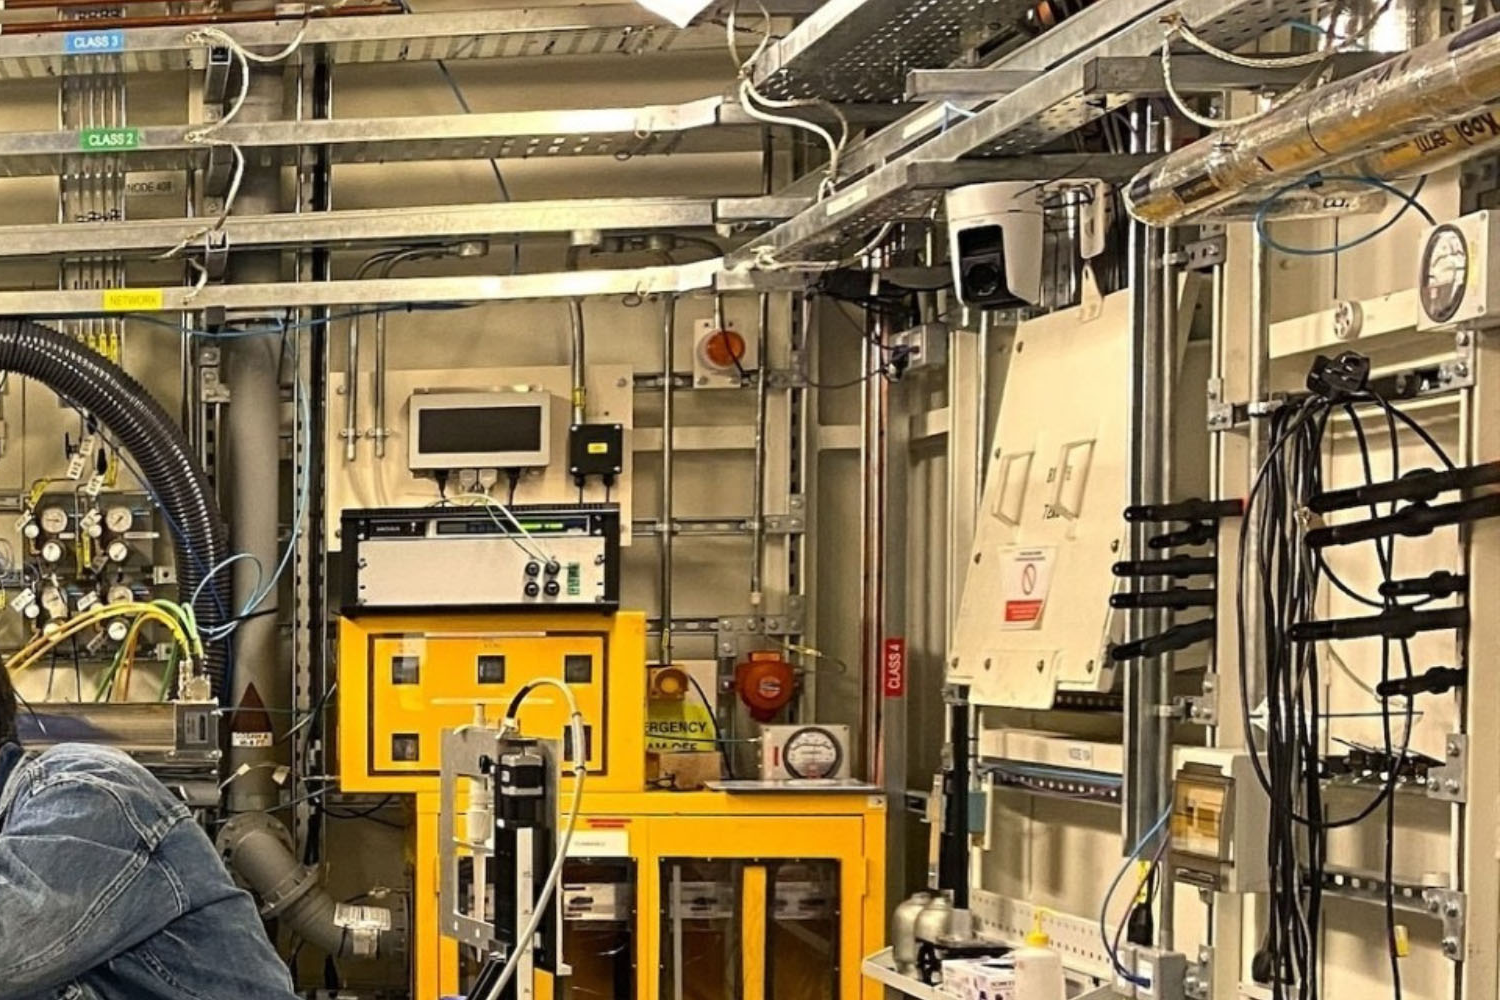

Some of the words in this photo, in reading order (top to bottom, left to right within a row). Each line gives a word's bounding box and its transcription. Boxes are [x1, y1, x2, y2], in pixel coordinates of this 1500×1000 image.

[74, 35, 109, 48] CLASS
[111, 35, 118, 47] 3
[88, 133, 124, 146] CLASS
[126, 132, 134, 144] 2
[126, 182, 154, 193] NODE
[110, 295, 157, 306] NETWORK
[888, 653, 901, 689] CLASS
